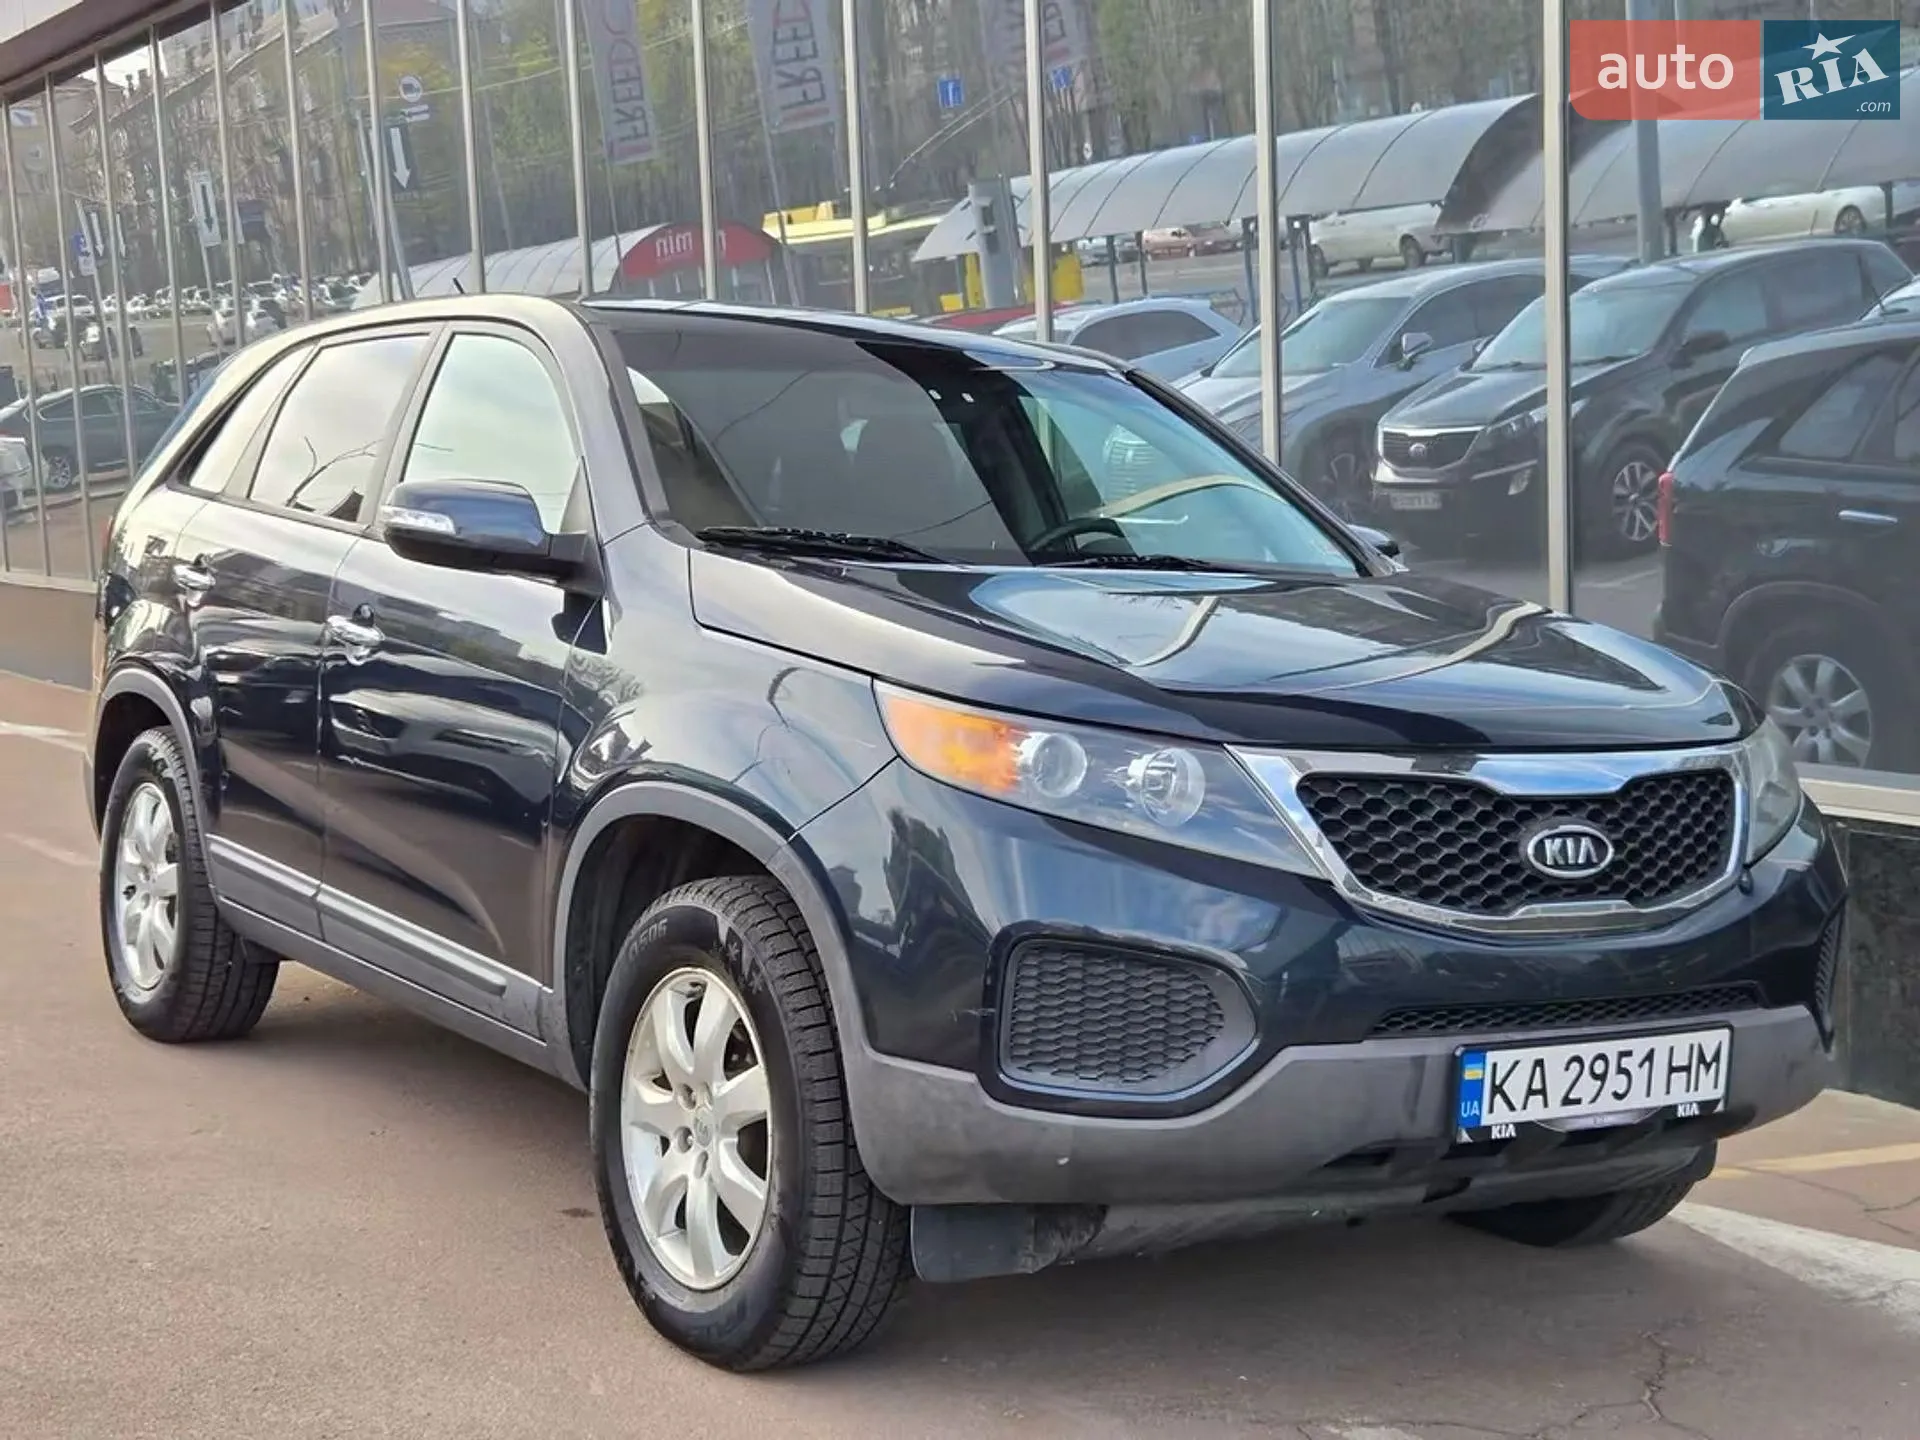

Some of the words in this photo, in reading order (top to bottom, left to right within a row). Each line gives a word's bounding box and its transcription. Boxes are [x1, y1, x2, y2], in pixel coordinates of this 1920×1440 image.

[1544, 837, 1598, 865] KIA
[1488, 1058, 1549, 1114] KA
[1561, 1048, 1655, 1108] 2951
[1665, 1040, 1722, 1095] HM
[1461, 1100, 1480, 1117] UA
[1677, 1102, 1699, 1118] KIA
[1491, 1123, 1516, 1139] KIA
